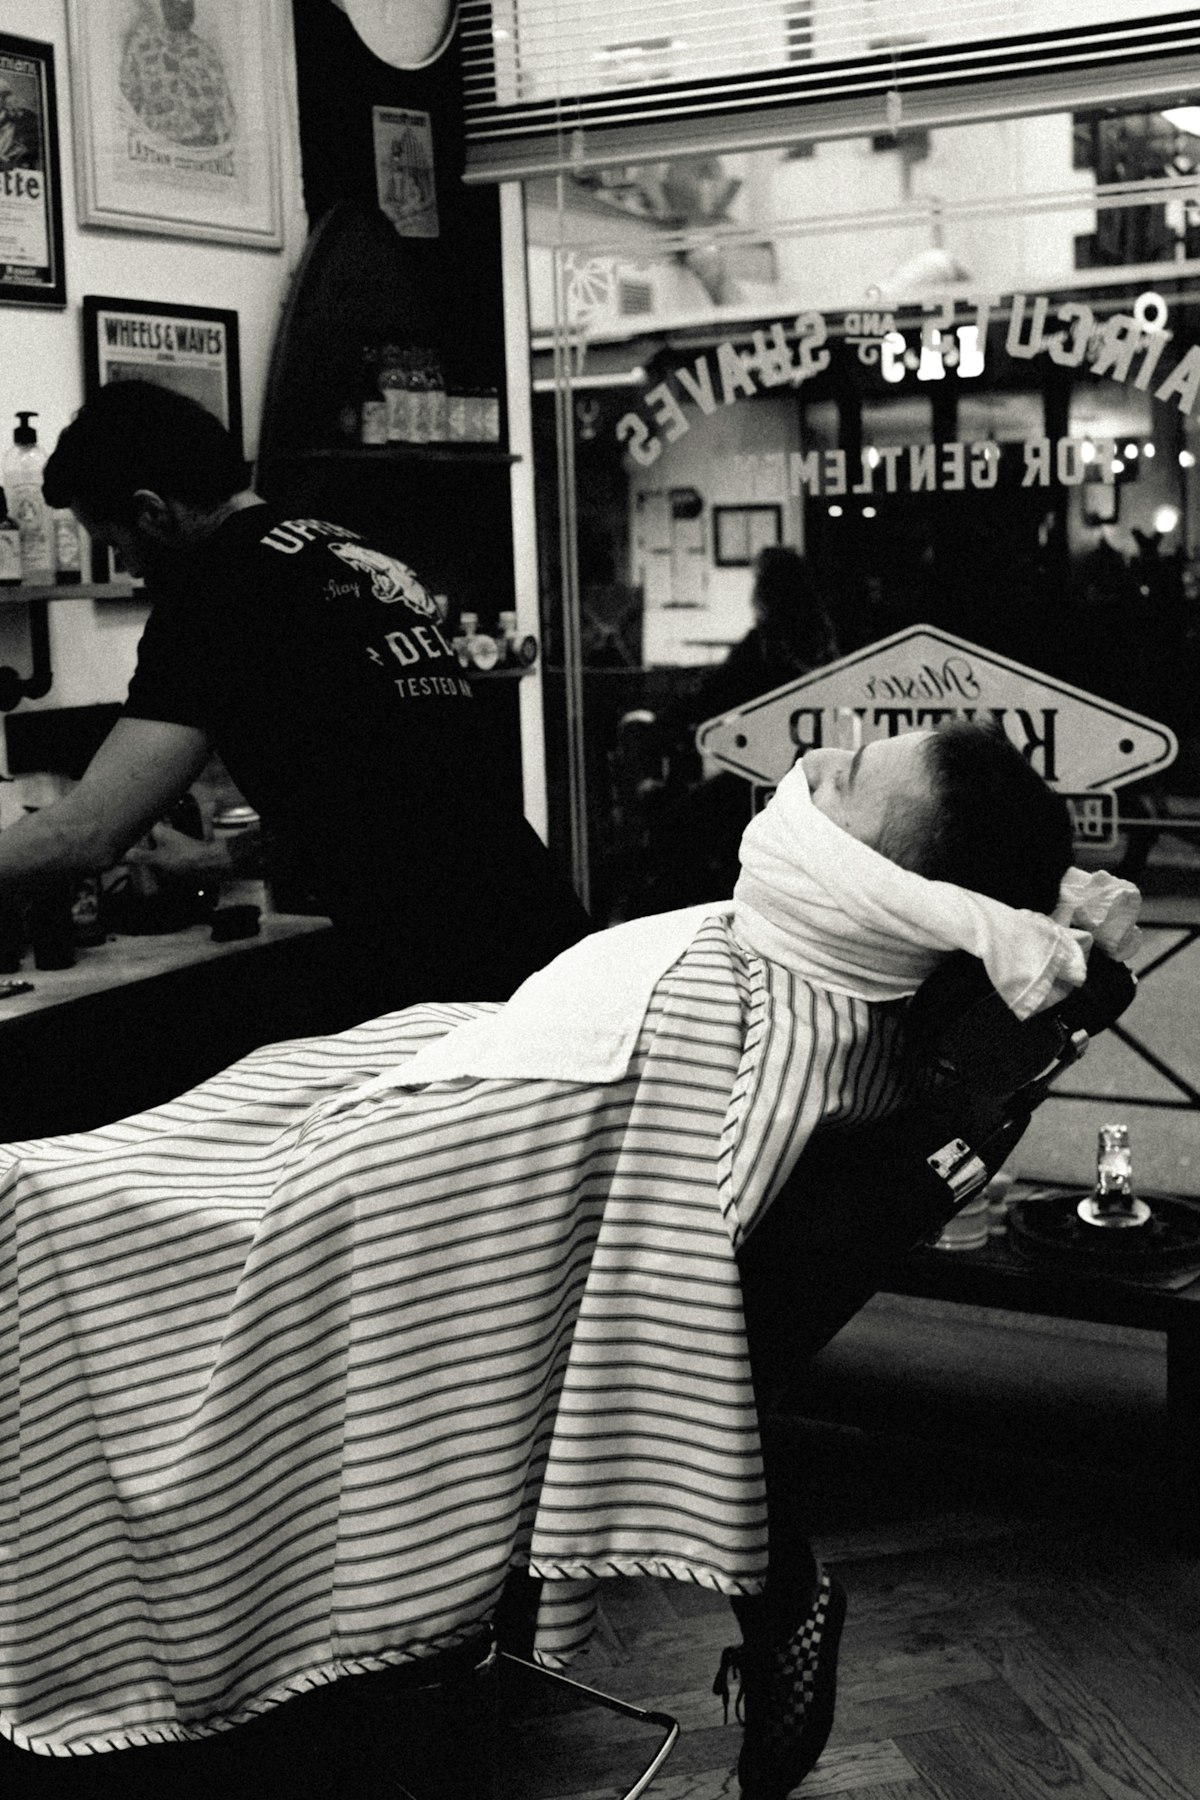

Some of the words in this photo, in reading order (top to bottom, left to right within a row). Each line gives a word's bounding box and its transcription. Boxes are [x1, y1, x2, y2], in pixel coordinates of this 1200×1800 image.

[0, 170, 40, 200] tte
[105, 318, 160, 349] WHEELS
[163, 325, 174, 351] &
[175, 325, 222, 354] WAVES
[322, 578, 361, 601] Stay
[393, 676, 458, 698] TESTED
